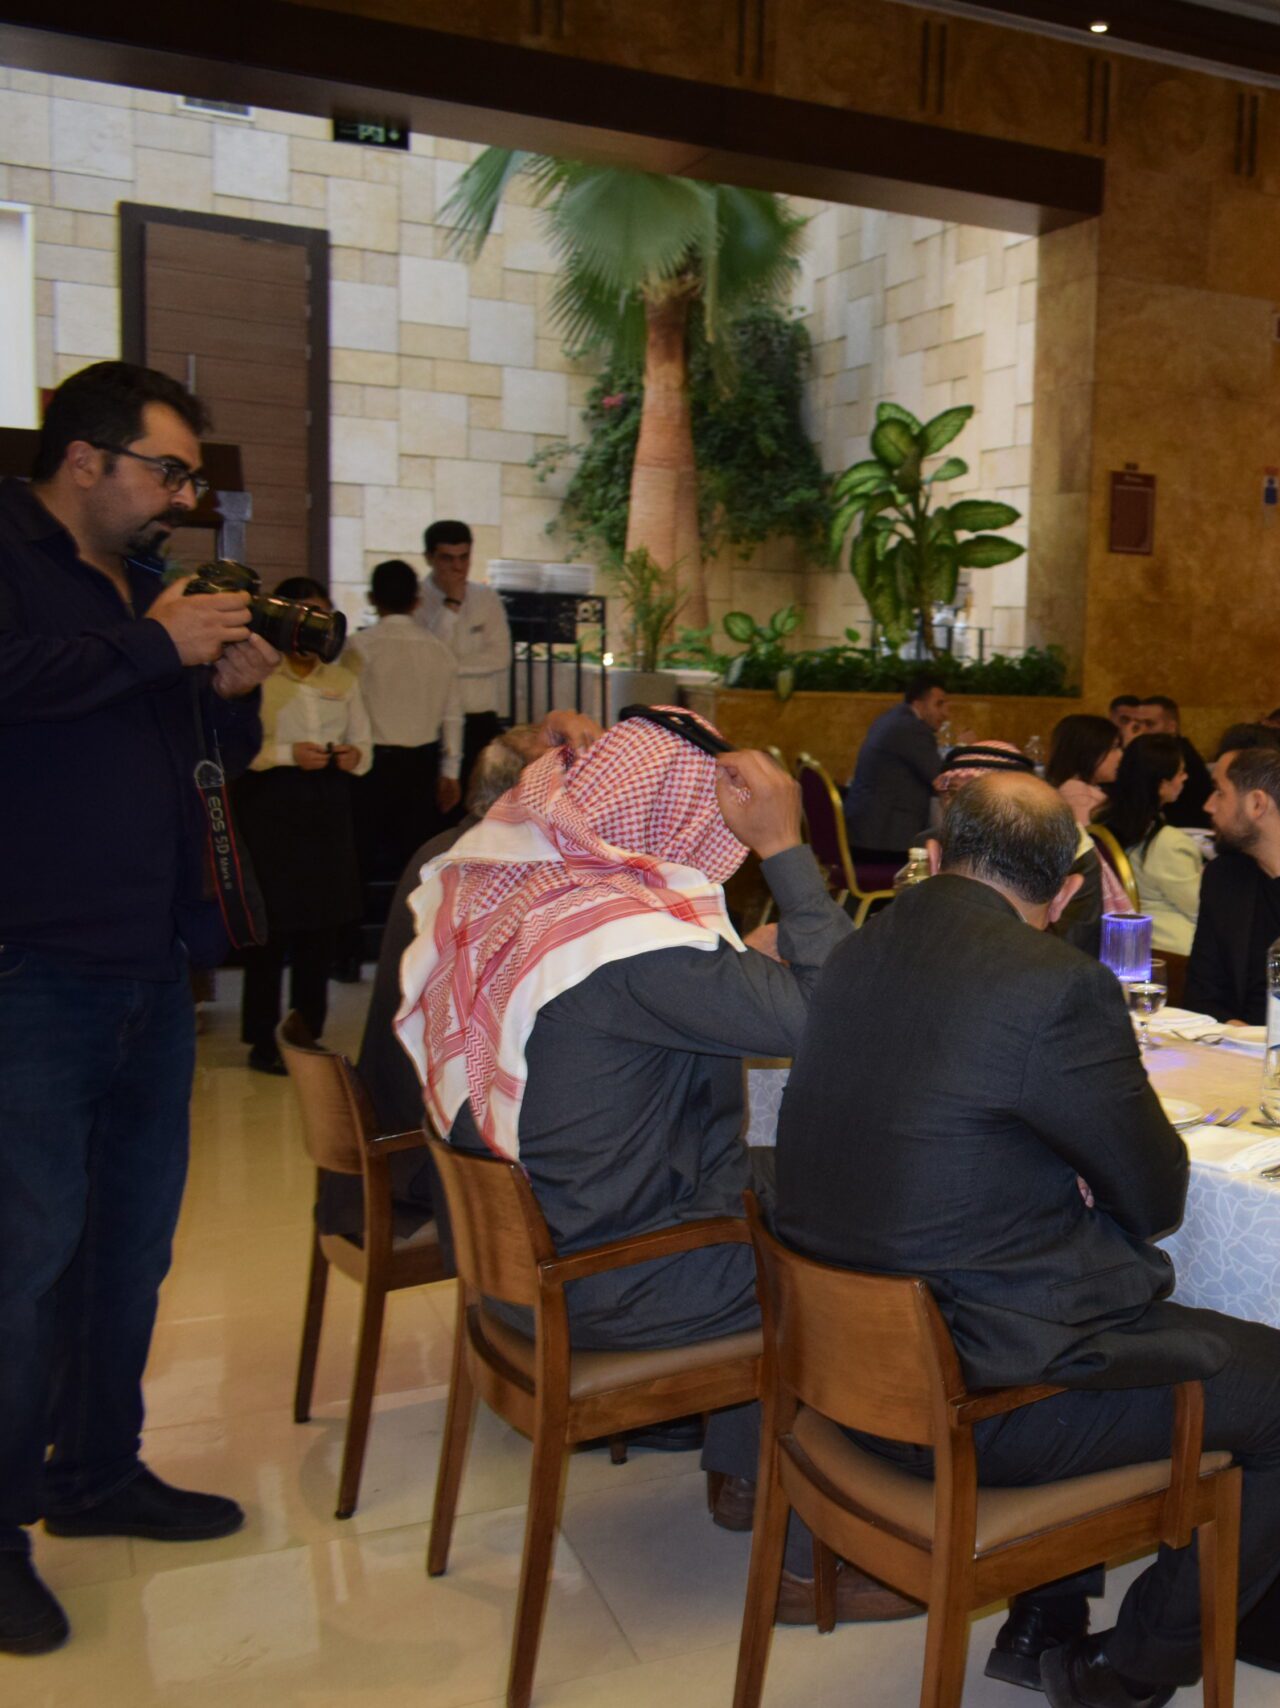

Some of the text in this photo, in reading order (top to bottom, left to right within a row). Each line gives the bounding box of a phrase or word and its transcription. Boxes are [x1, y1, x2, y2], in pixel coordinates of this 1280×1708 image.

[208, 796, 225, 832] EOS
[215, 836, 230, 854] 5D
[220, 857, 230, 880] Mark
